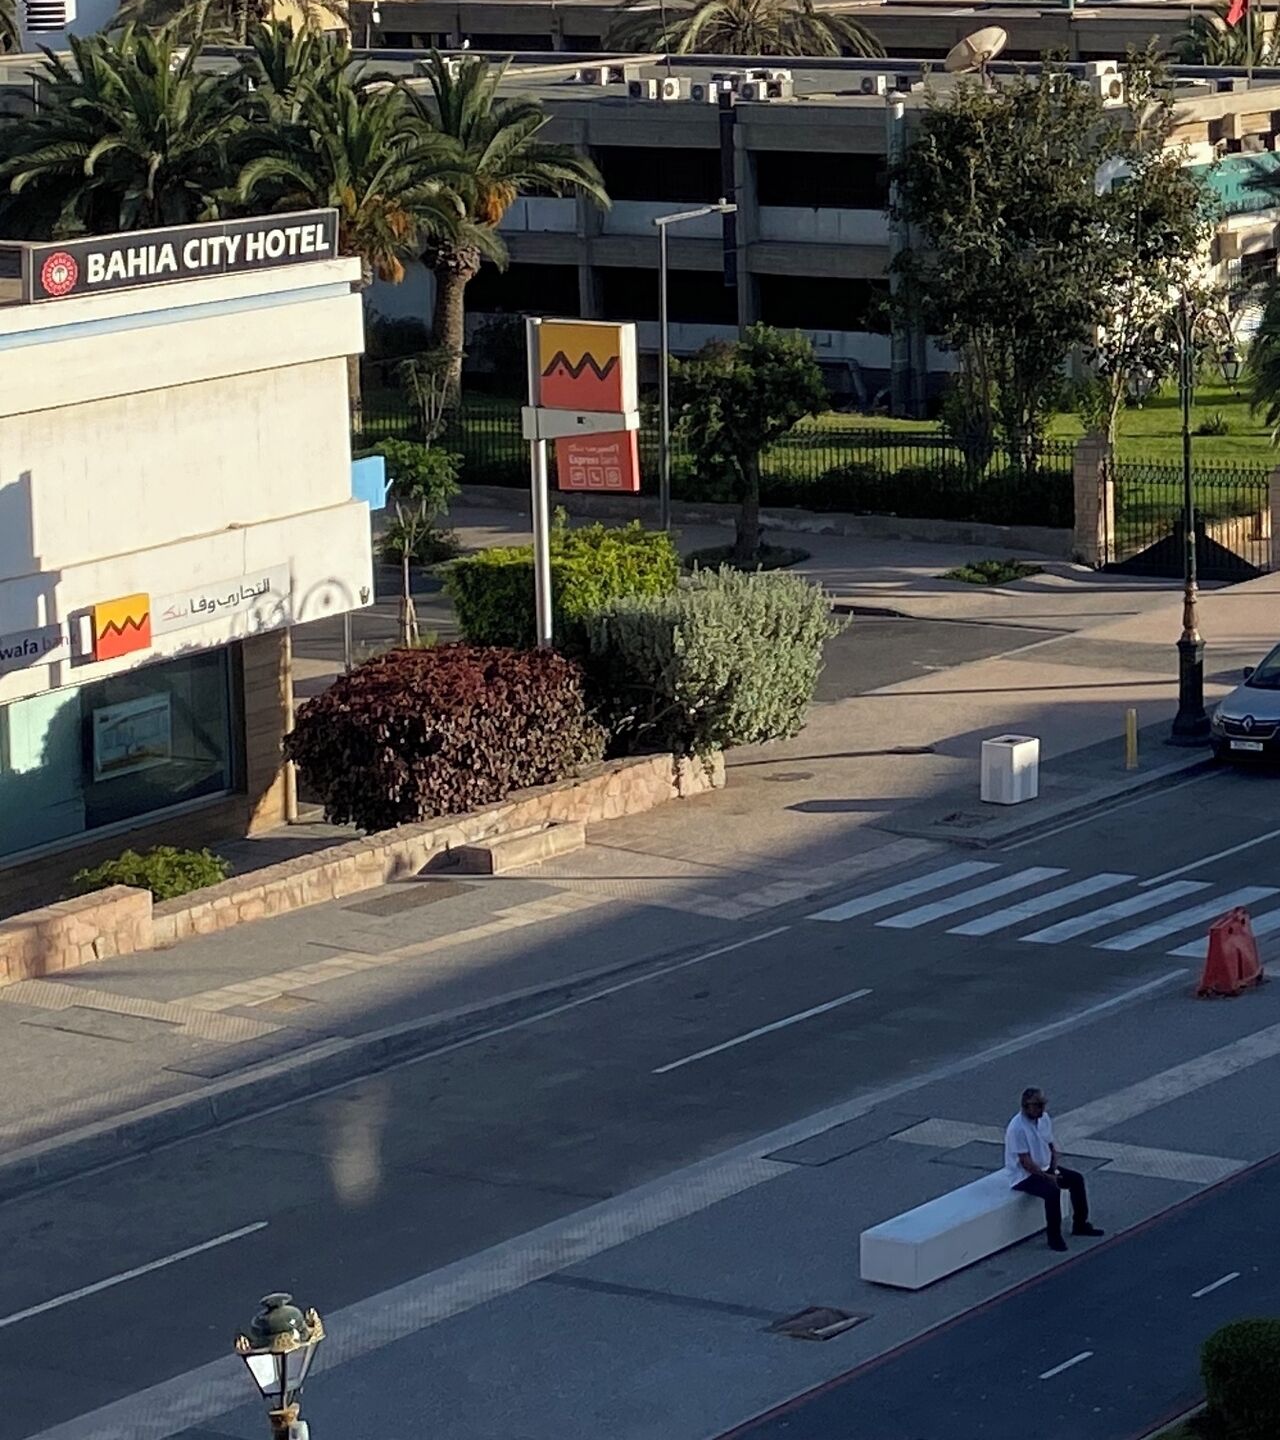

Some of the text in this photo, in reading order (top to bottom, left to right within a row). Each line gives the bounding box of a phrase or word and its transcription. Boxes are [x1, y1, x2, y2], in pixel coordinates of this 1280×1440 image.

[87, 223, 330, 283] BAHIA CITY HOTEL
